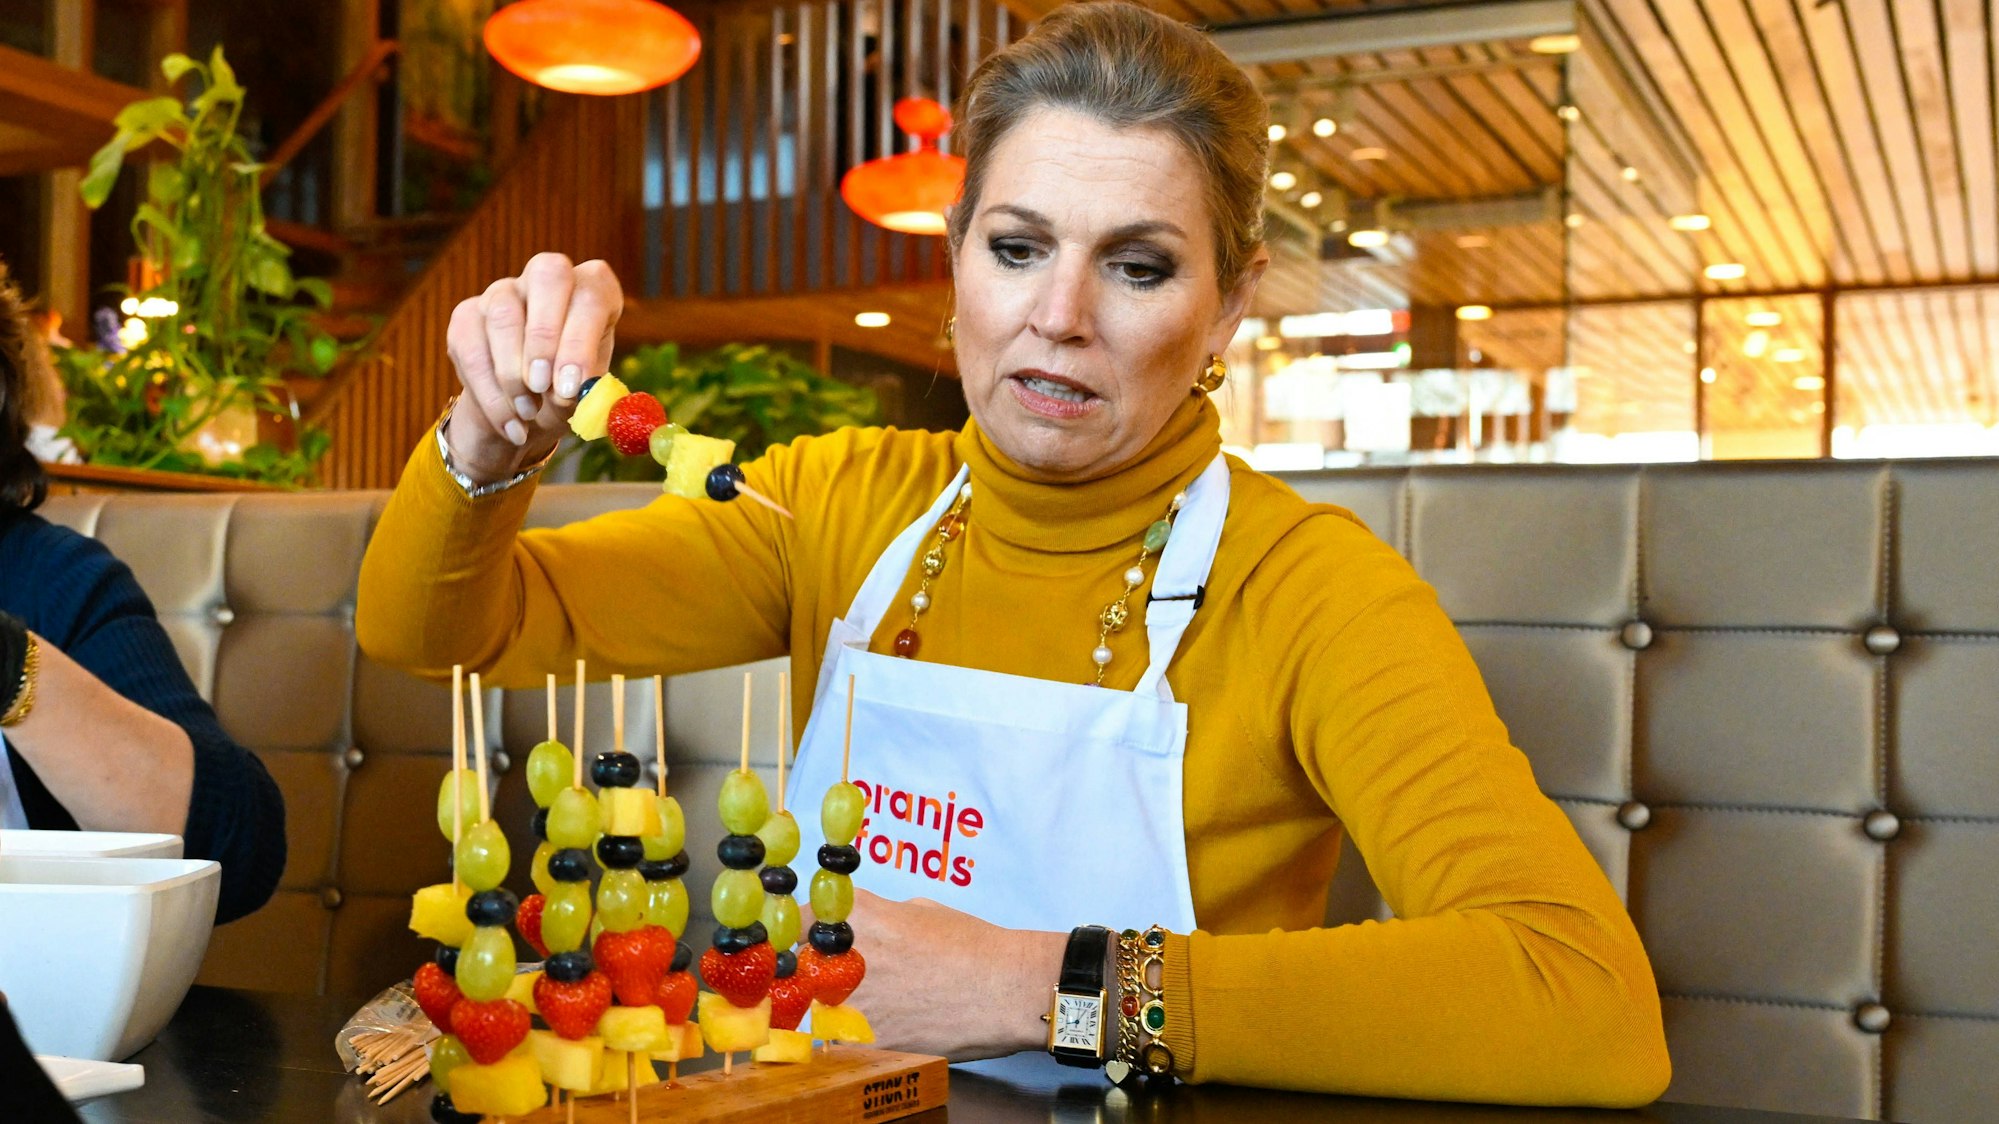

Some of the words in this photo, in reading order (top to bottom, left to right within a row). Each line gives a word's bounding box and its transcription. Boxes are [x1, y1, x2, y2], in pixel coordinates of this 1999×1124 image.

[855, 818, 975, 887] fonds
[864, 1077, 902, 1109] STICK
[907, 1072, 920, 1099] IT
